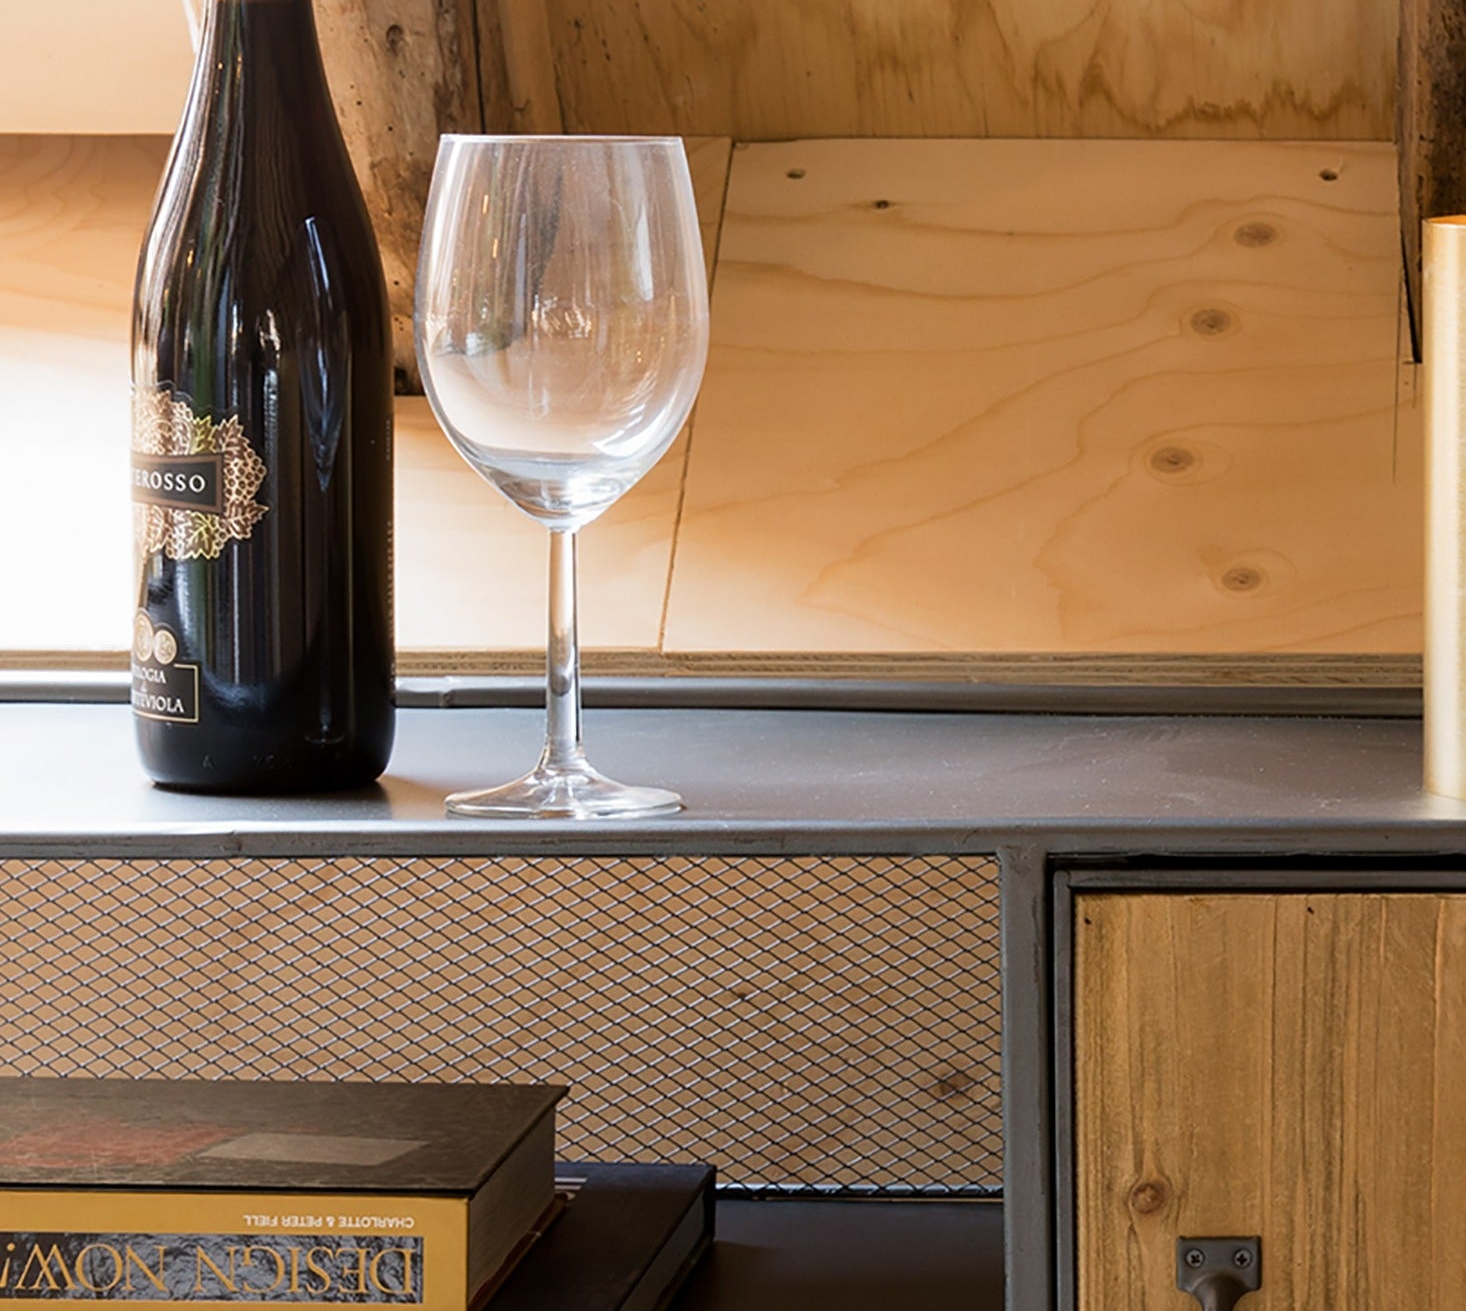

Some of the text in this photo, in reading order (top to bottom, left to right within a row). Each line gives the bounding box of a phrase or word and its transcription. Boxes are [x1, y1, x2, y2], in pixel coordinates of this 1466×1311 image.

[243, 1214, 416, 1228] CHARLOTTE & PETER FIELL
[0, 1242, 417, 1295] DESIGN NOW!
